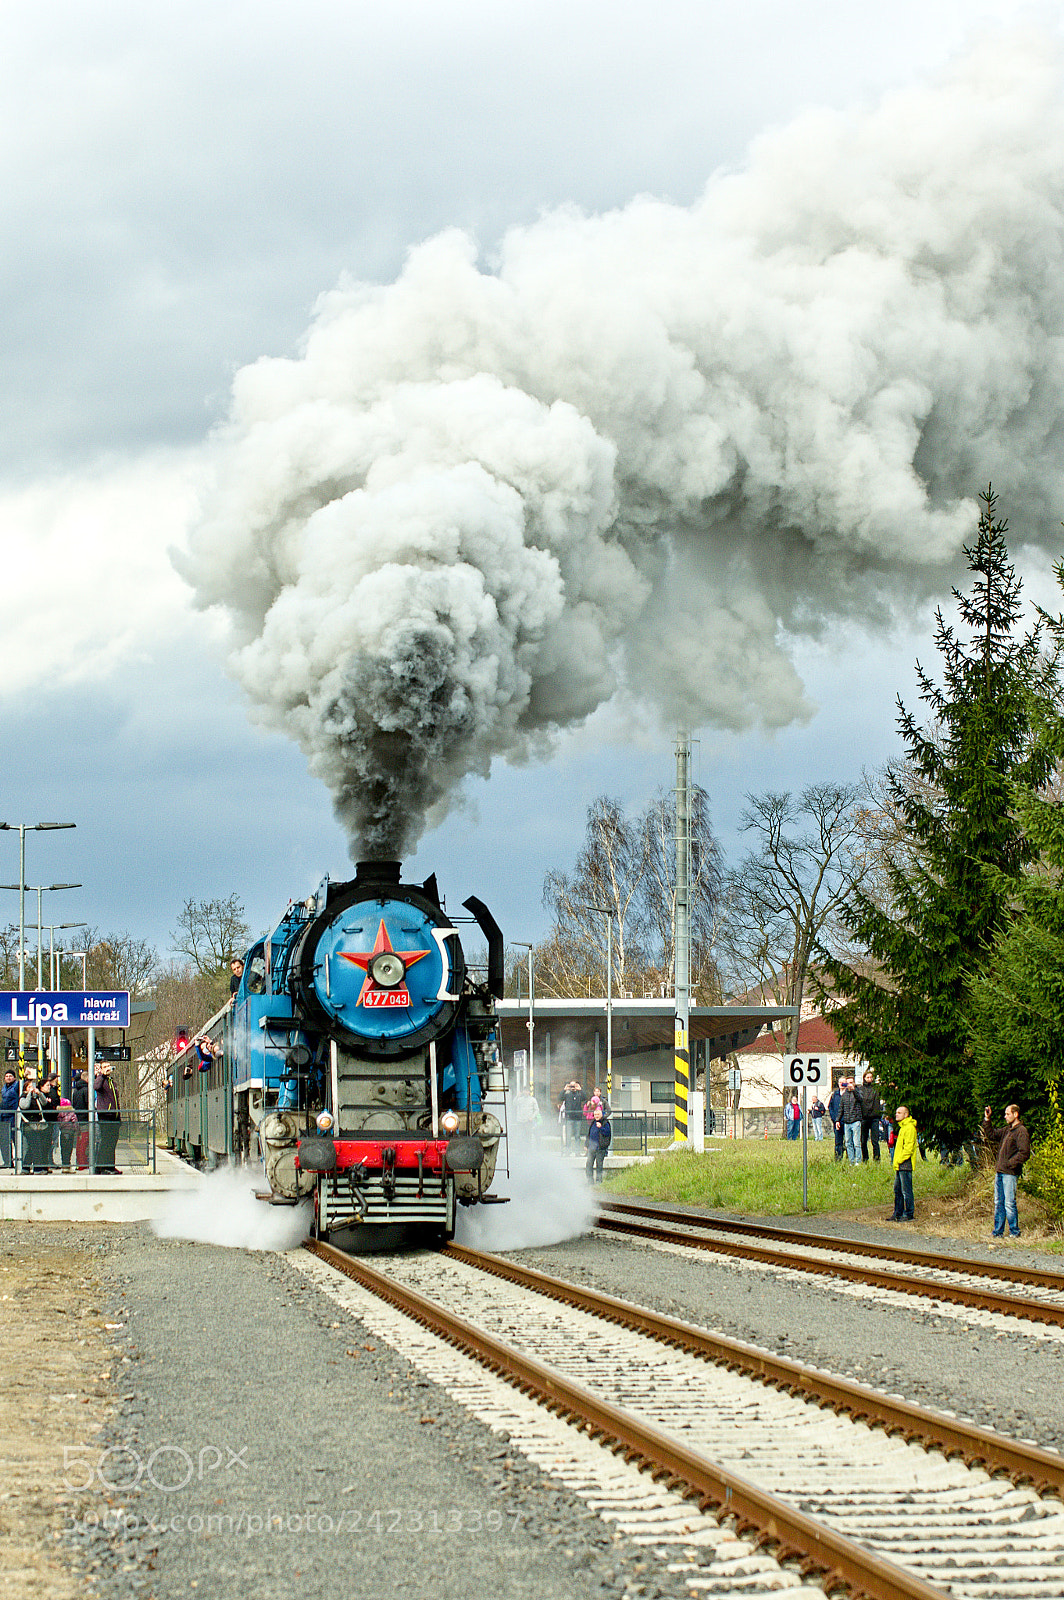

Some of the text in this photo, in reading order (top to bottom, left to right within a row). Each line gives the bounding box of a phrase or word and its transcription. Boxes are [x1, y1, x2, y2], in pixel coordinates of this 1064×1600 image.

[83, 997, 116, 1008] hlavní
[365, 992, 407, 1006] 477 043
[11, 997, 68, 1026] Lípa
[80, 1010, 120, 1021] nádraží
[790, 1058, 821, 1083] 65
